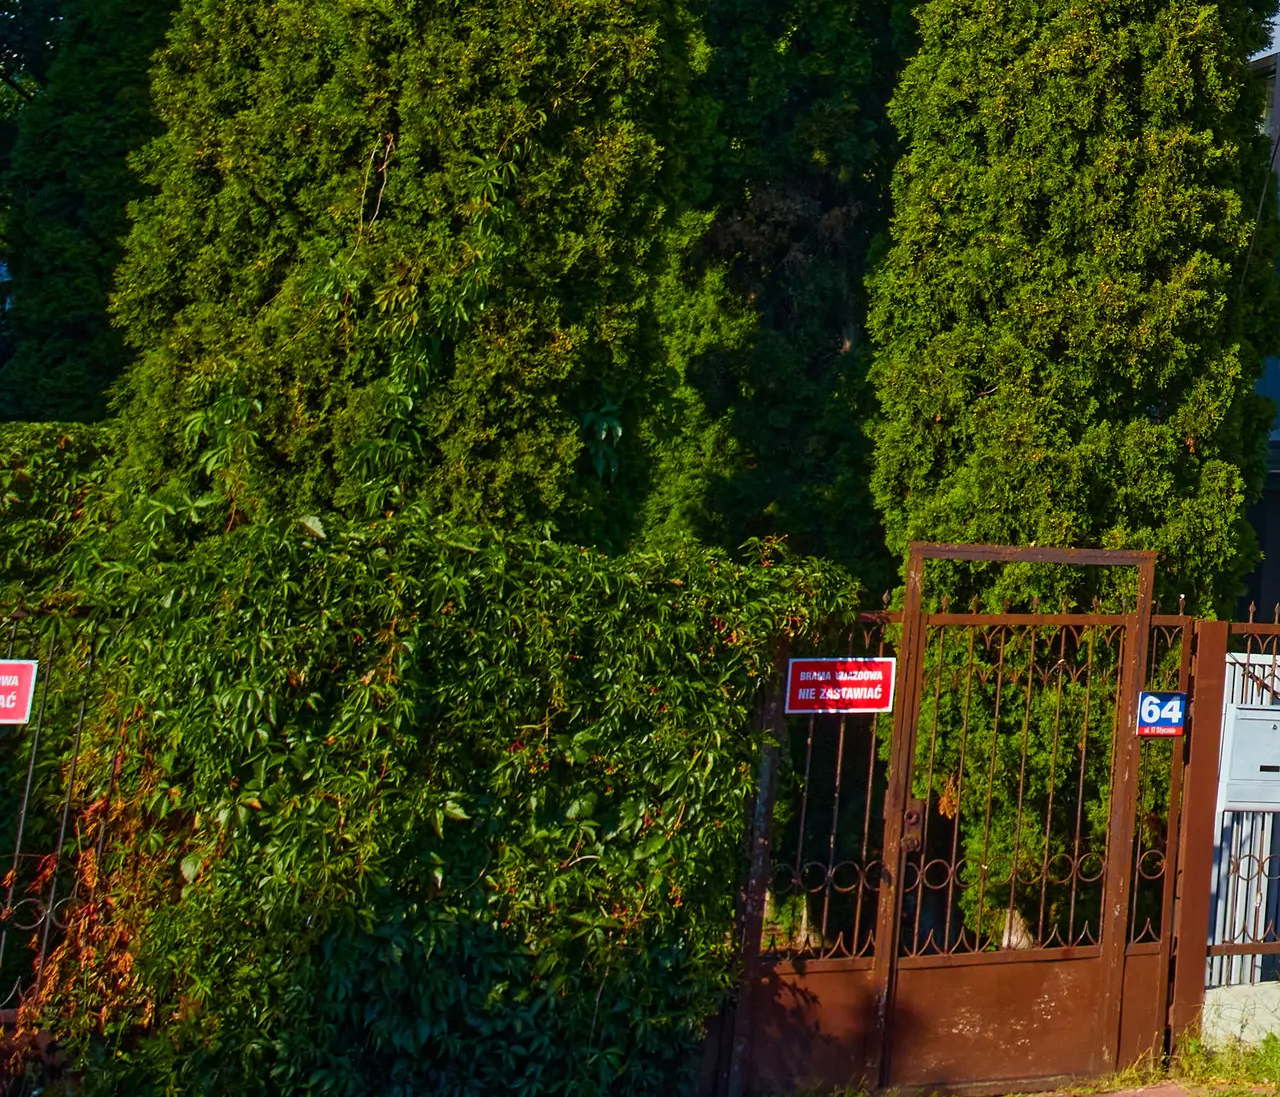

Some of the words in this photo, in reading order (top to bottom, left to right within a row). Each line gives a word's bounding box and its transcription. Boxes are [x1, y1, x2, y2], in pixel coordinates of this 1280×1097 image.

[800, 671, 831, 681] BRAMA
[835, 670, 883, 681] WJAZDOWA
[798, 688, 816, 700] NIE
[820, 685, 882, 700] ZASTAWIAĆ
[1141, 695, 1182, 724] 64
